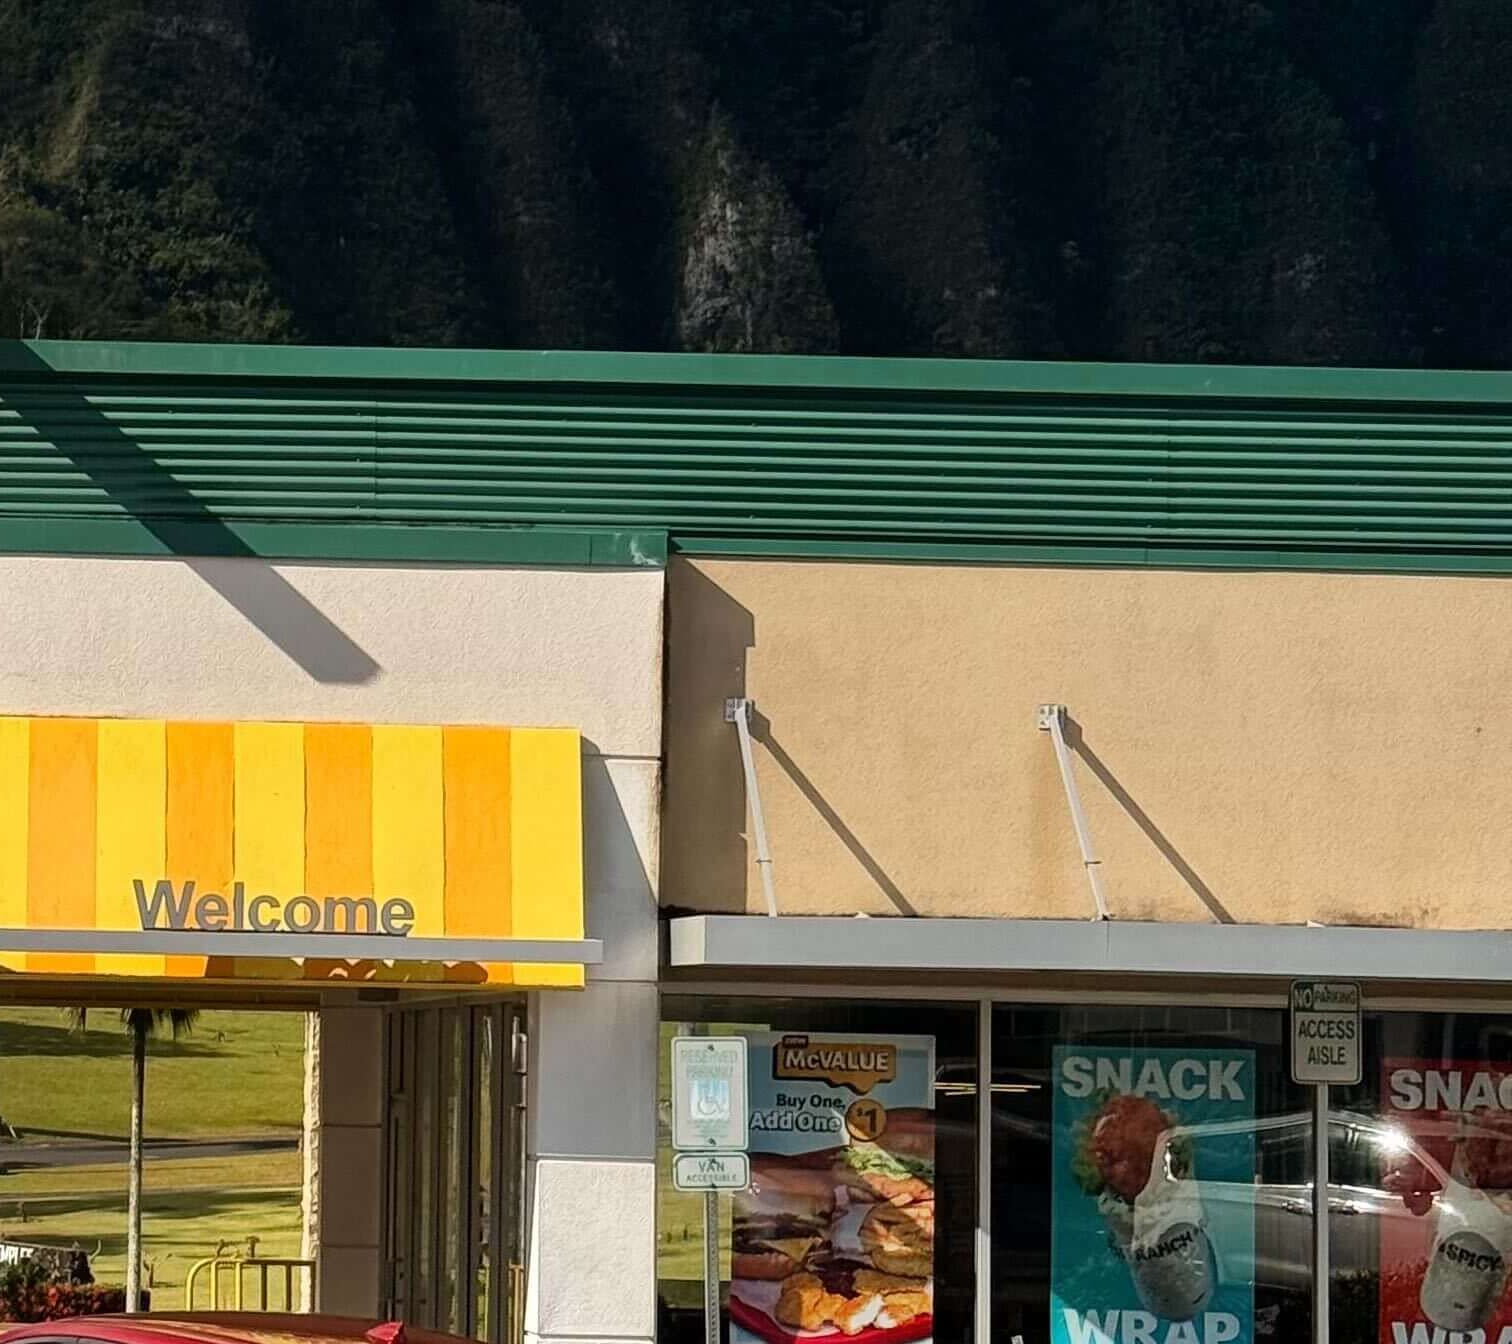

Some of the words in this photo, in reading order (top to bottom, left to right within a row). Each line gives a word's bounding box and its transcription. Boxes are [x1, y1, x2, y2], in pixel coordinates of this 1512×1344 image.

[133, 879, 415, 936] Welcome
[1294, 988, 1313, 1008] NO
[1299, 1020, 1355, 1040] ACCESS
[785, 1050, 889, 1072] McVALUE
[1308, 1046, 1346, 1065] AISLE
[1061, 1056, 1245, 1101] SNACK
[776, 1093, 806, 1110] Buy
[810, 1094, 846, 1109] One,
[751, 1111, 793, 1131] Add
[795, 1112, 842, 1132] One
[698, 1160, 725, 1173] VAN
